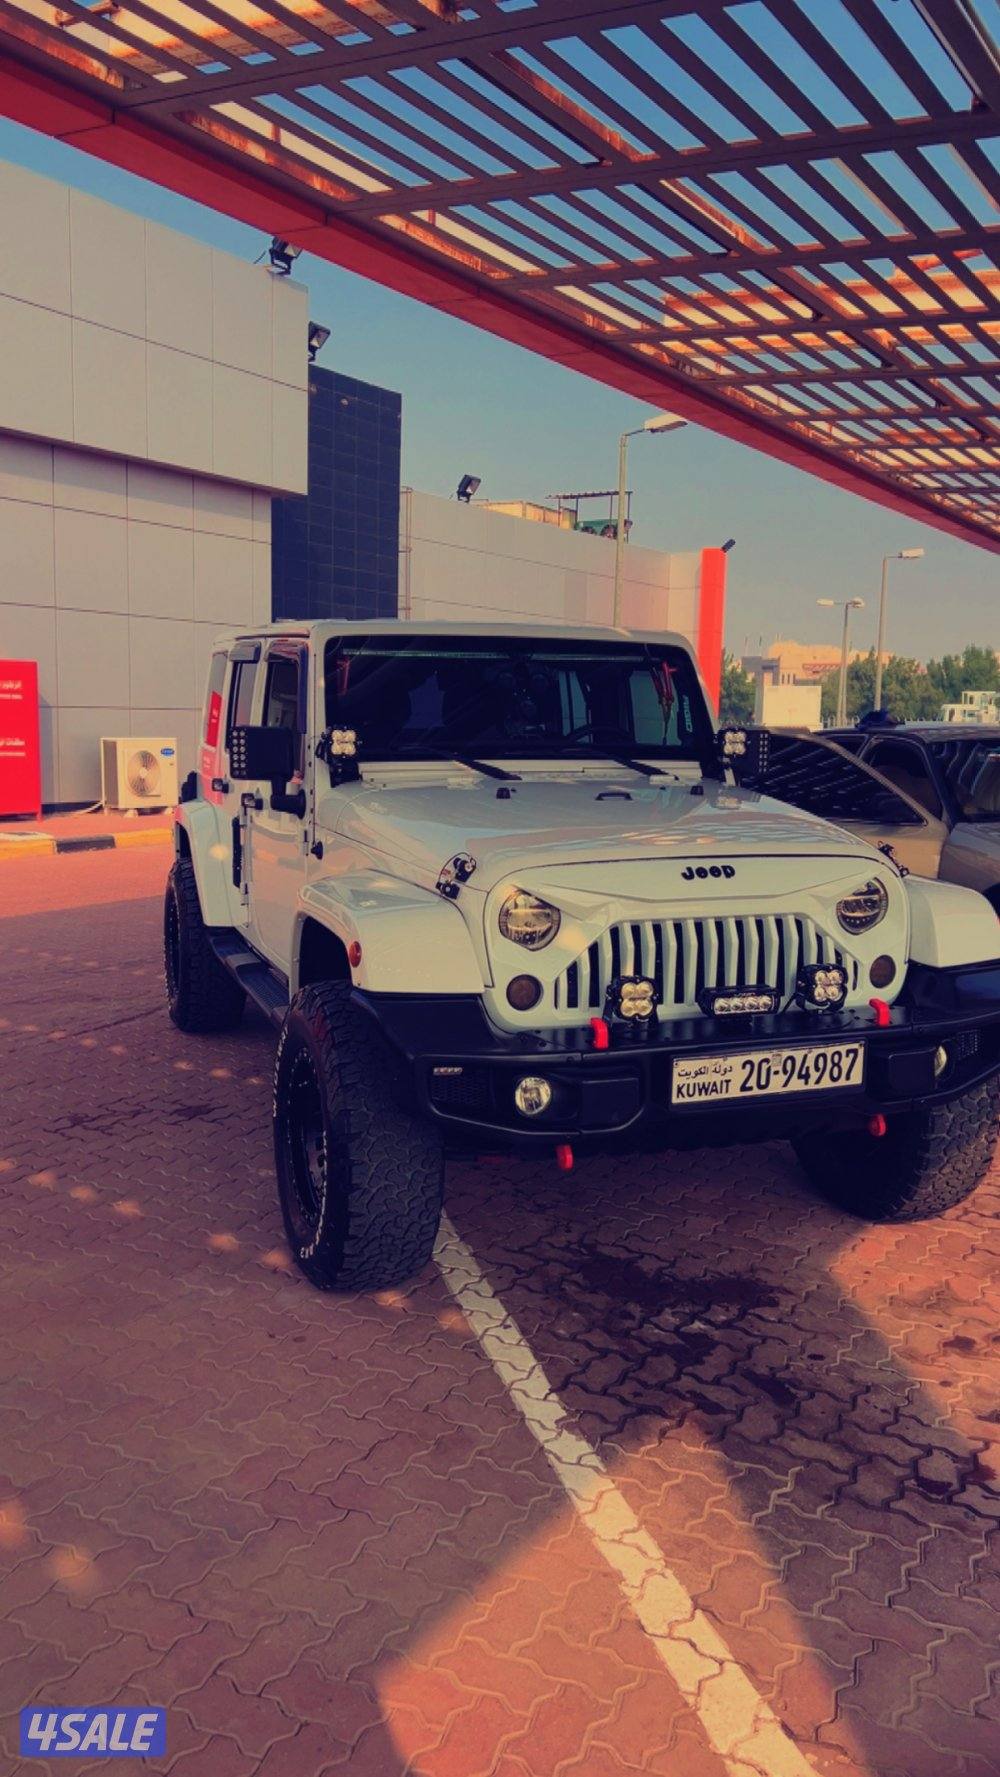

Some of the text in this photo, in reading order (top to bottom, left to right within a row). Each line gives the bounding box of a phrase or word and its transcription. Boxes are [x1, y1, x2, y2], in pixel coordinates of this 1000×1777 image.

[681, 865, 736, 880] Jeep
[678, 1063, 733, 1080] دولة الكويت
[739, 1048, 859, 1093] 20-94987
[676, 1079, 732, 1099] KUWAIT
